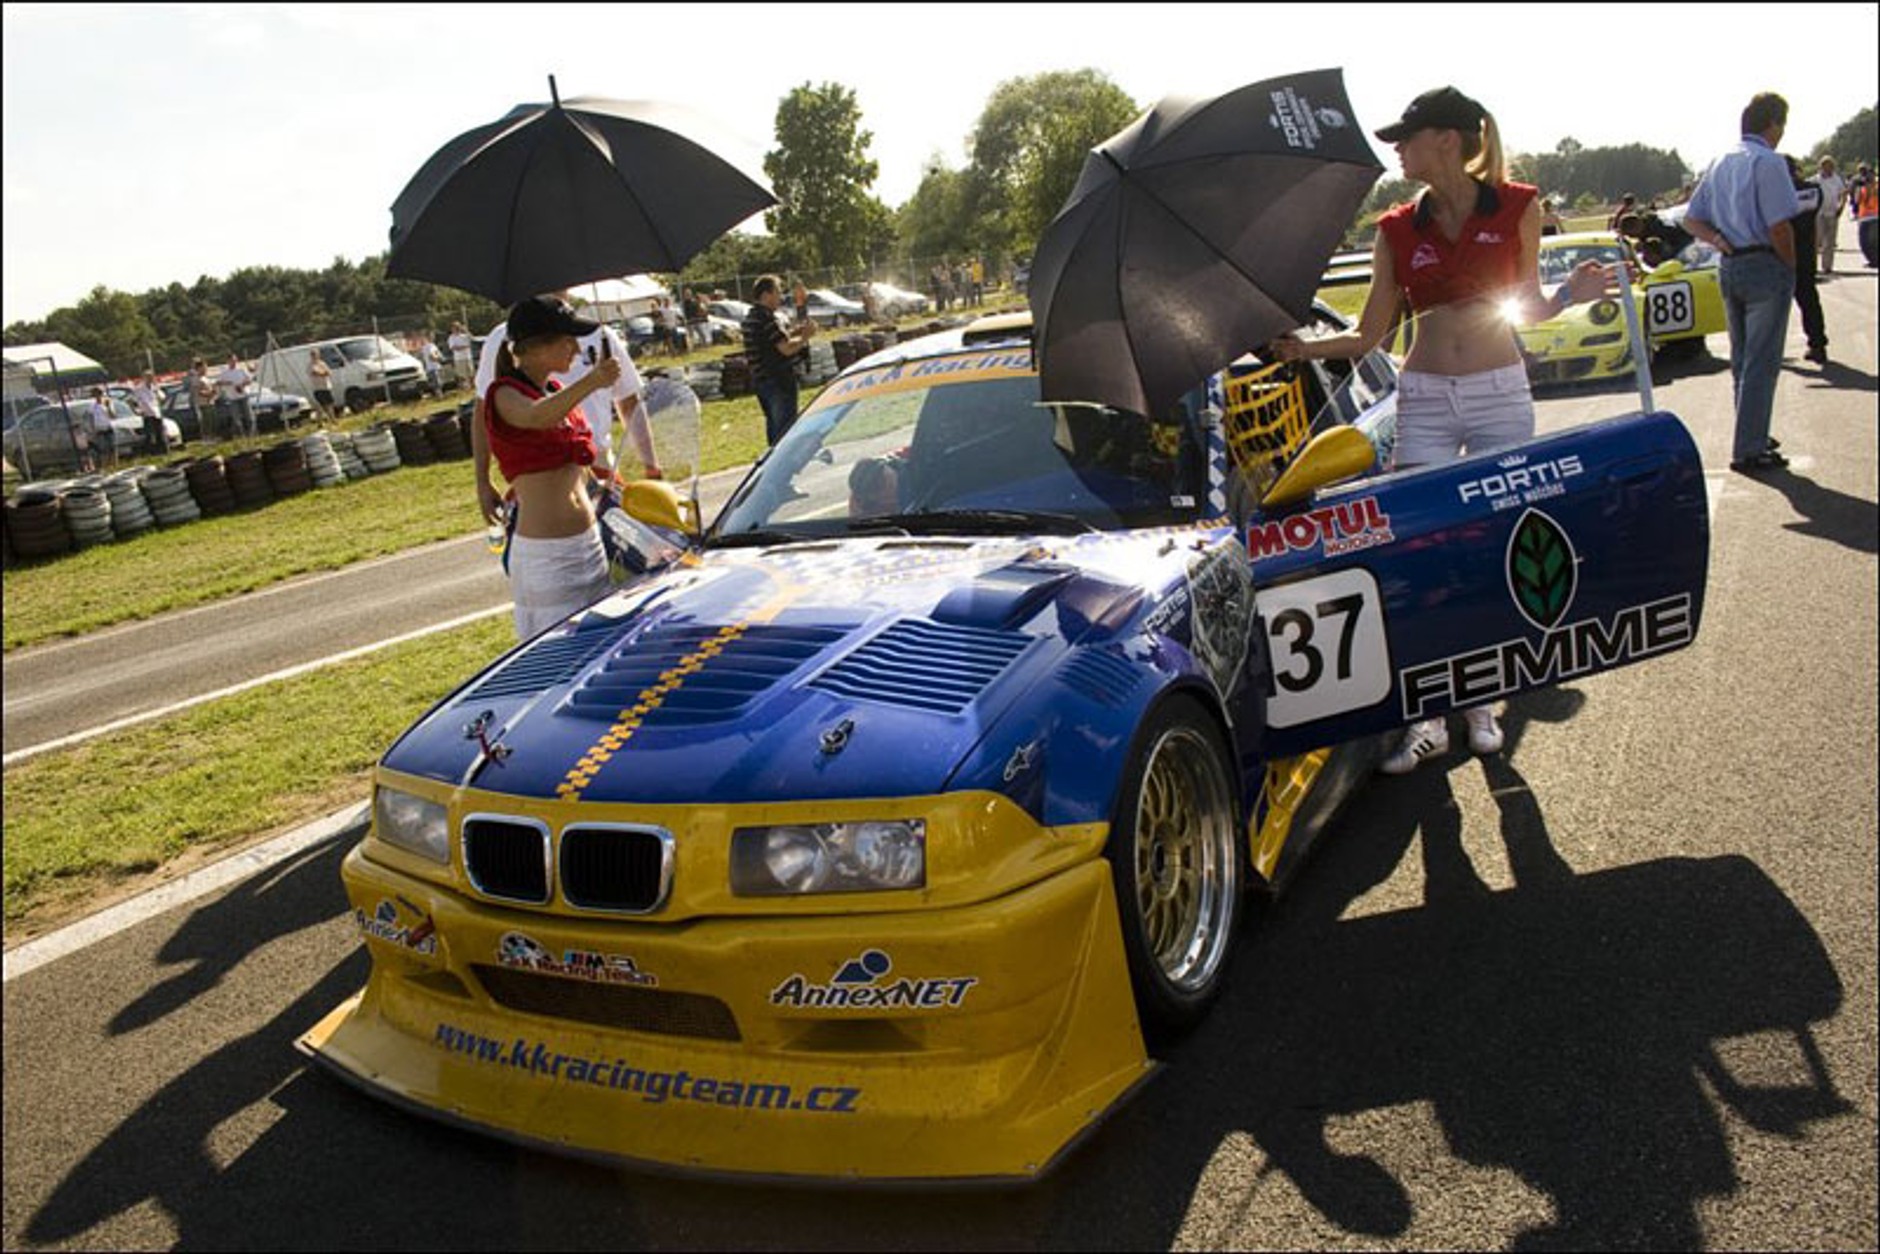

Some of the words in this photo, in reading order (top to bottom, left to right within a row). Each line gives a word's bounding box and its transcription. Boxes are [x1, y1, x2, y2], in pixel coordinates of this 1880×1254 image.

[1270, 91, 1303, 148] FORTIS
[1653, 290, 1688, 325] 88
[911, 353, 1031, 378] Racing
[1458, 455, 1583, 503] FORTIS
[1247, 496, 1390, 561] MOTUL
[1400, 592, 1692, 720] FEMME
[770, 975, 977, 1008] AnnexNET
[436, 1022, 861, 1113] www.kkracingteam.cz
